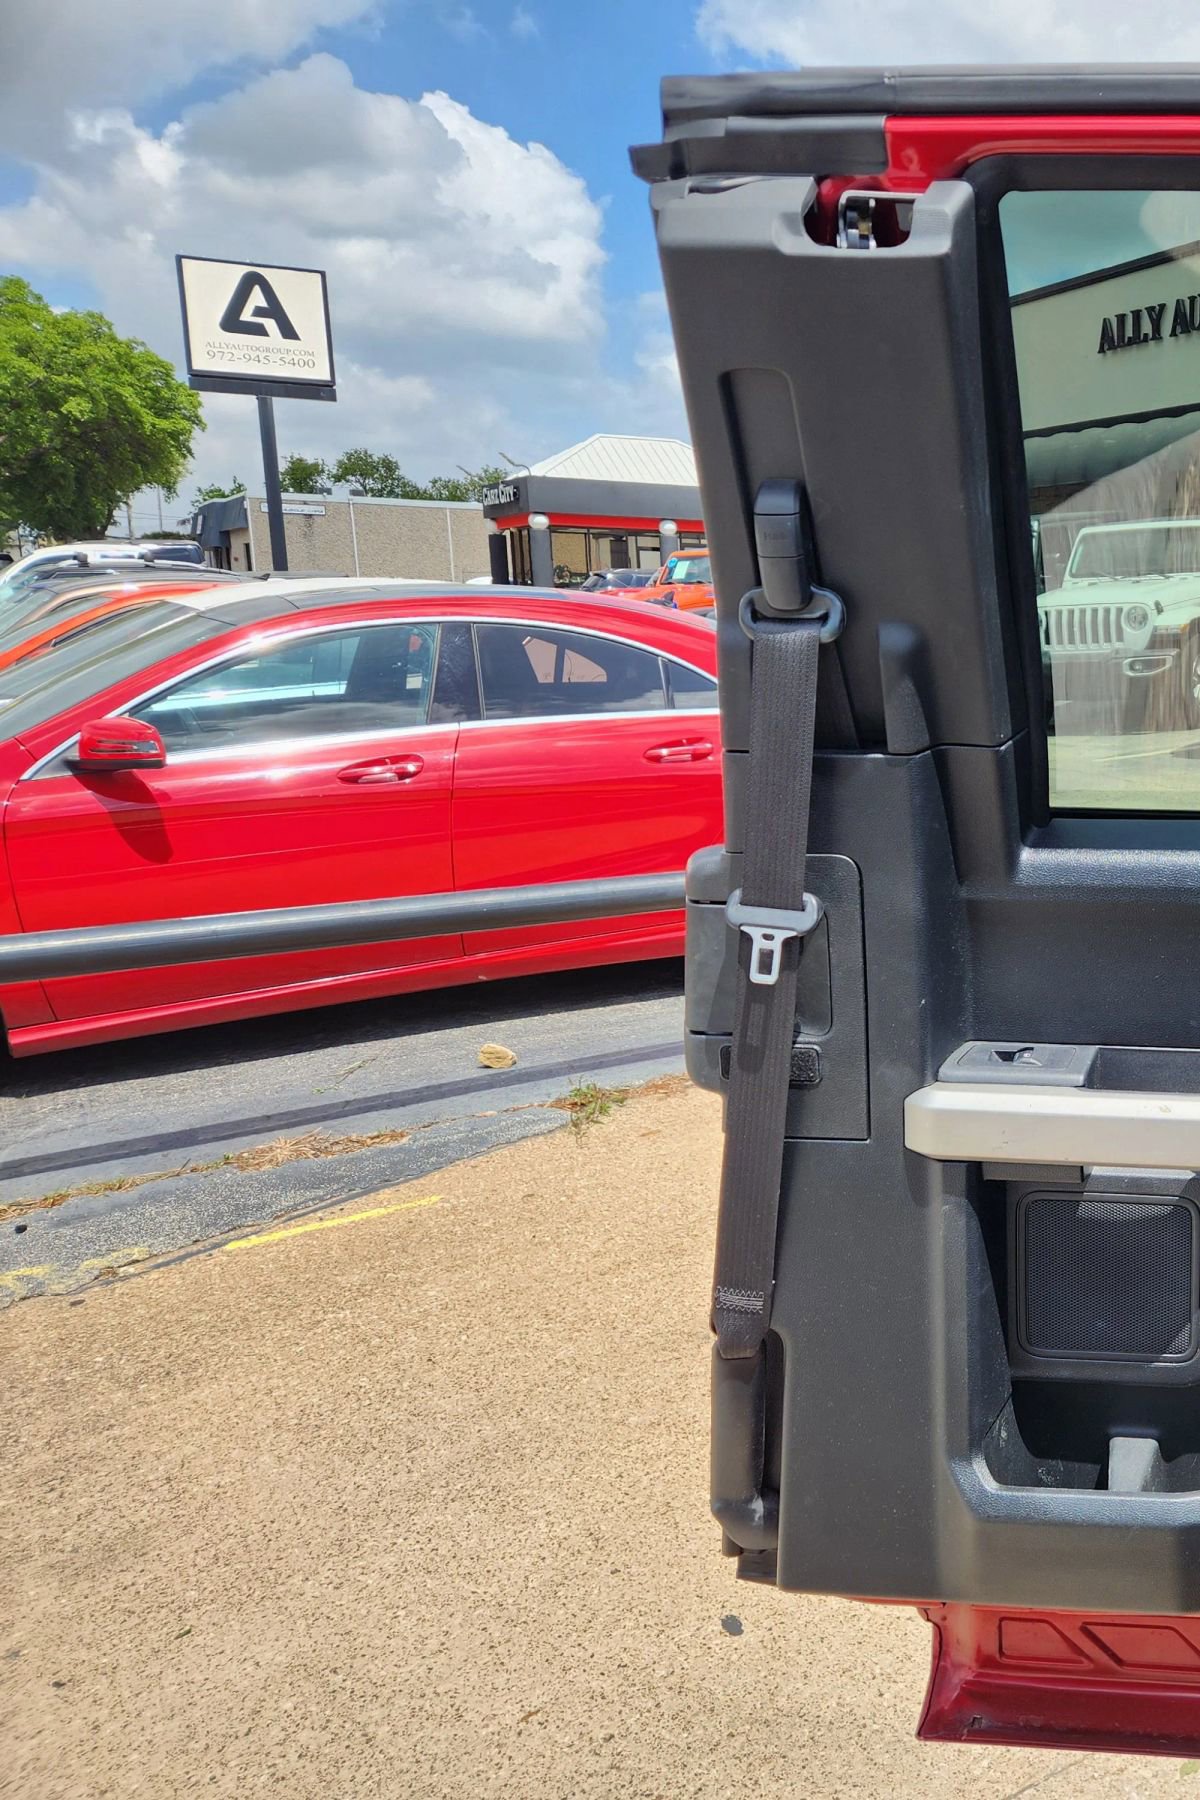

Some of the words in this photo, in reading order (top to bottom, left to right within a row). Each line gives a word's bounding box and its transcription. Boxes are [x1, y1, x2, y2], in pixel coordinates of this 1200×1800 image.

[1098, 302, 1166, 353] ALLY
[205, 341, 315, 357] ALLYAUTOGROUP.COM
[206, 350, 316, 369] 972-945-5400
